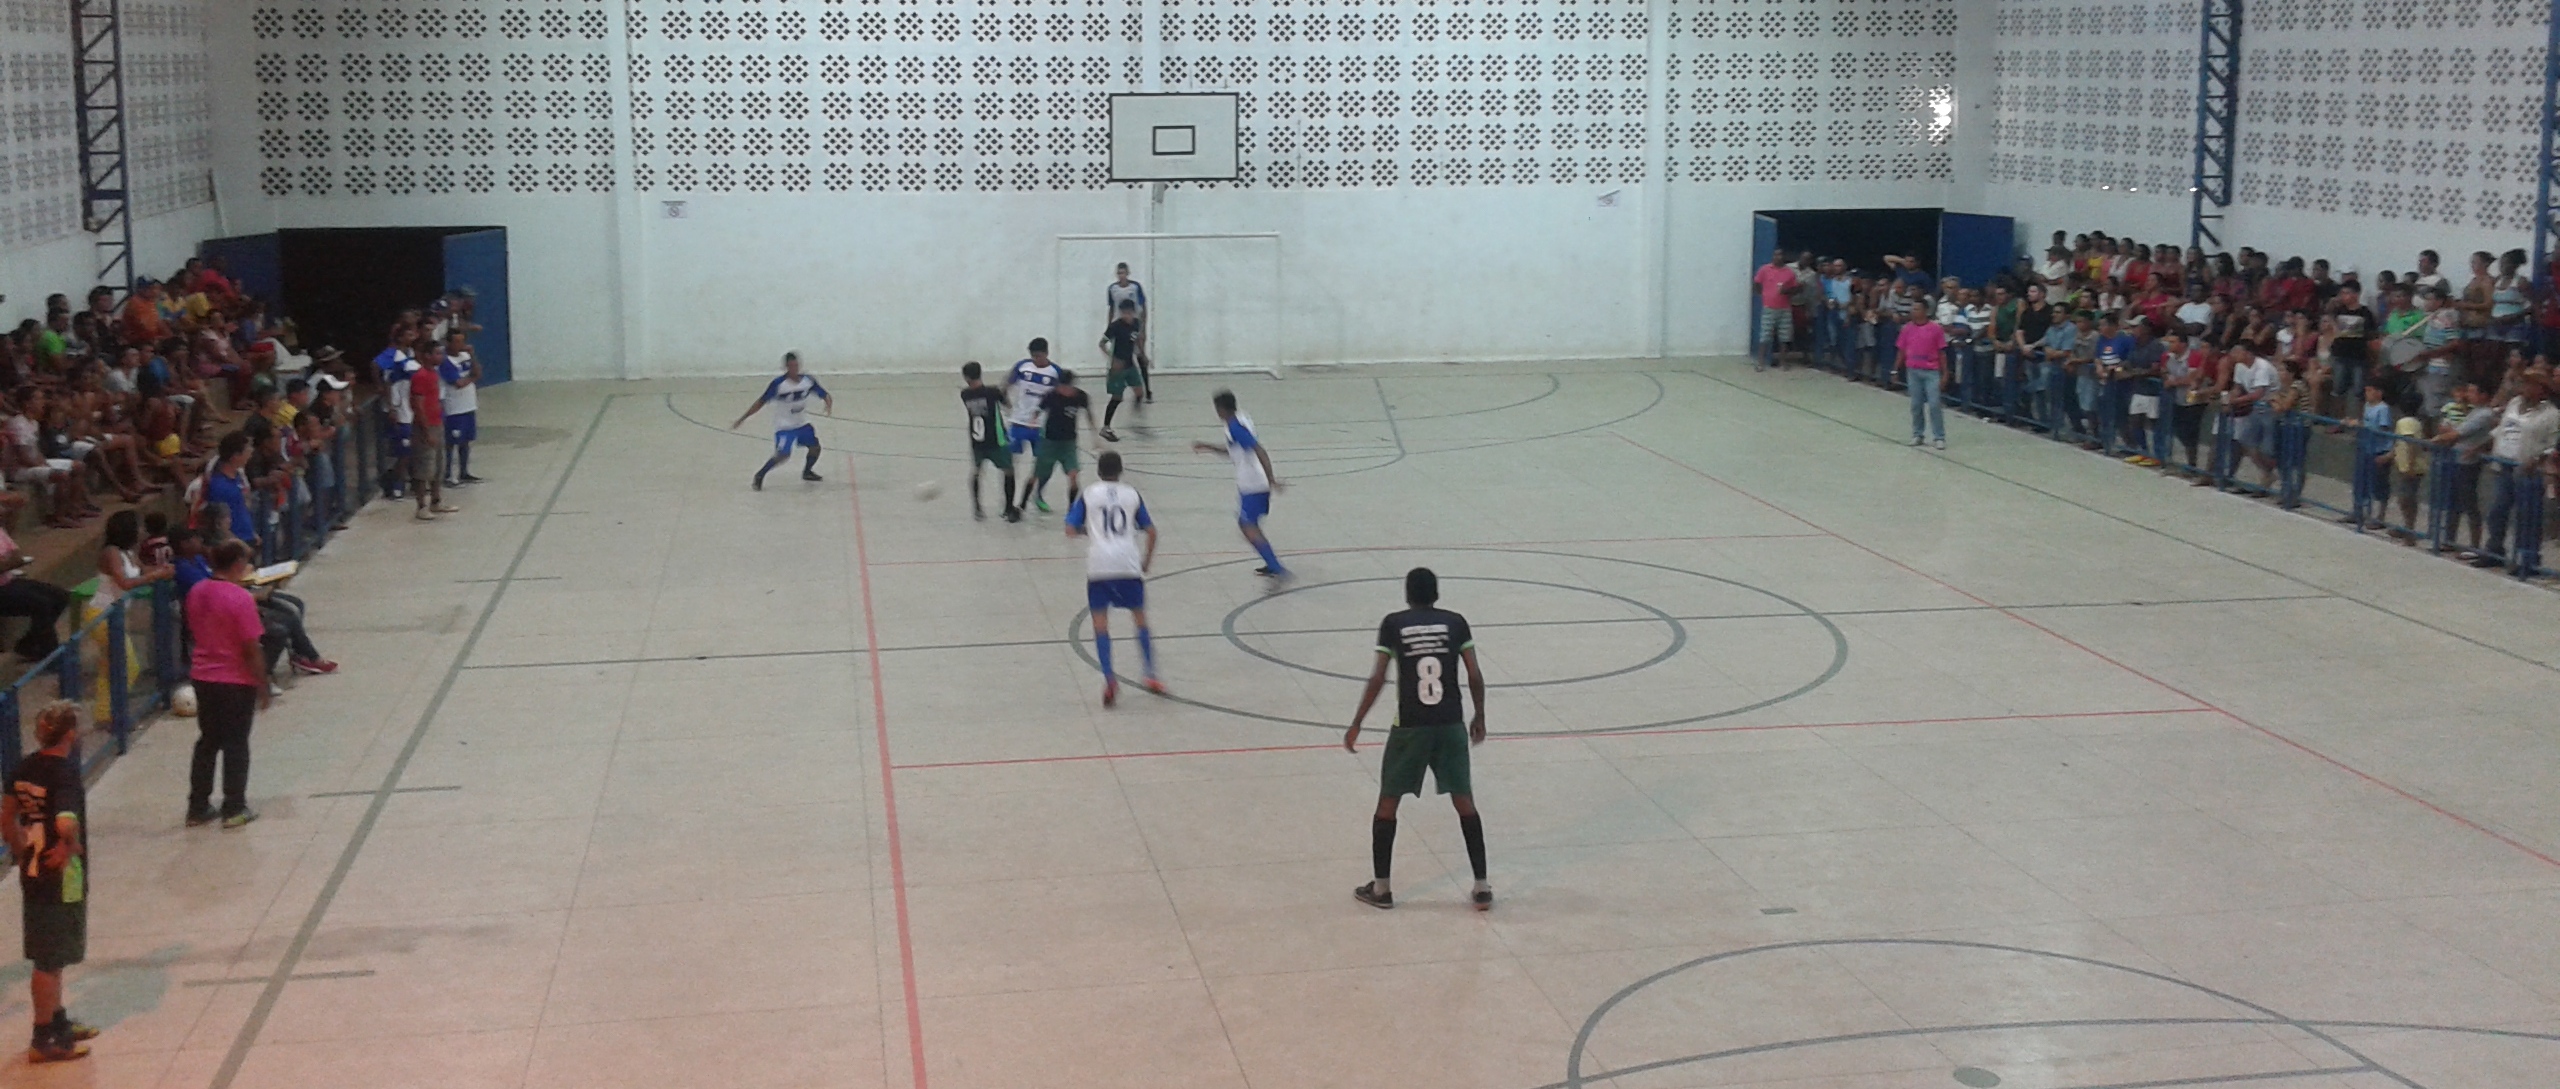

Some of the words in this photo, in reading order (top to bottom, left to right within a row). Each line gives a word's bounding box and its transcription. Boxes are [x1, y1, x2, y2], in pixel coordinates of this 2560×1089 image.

[972, 415, 986, 443] 9
[1099, 505, 1127, 539] 10
[1416, 656, 1444, 706] 8
